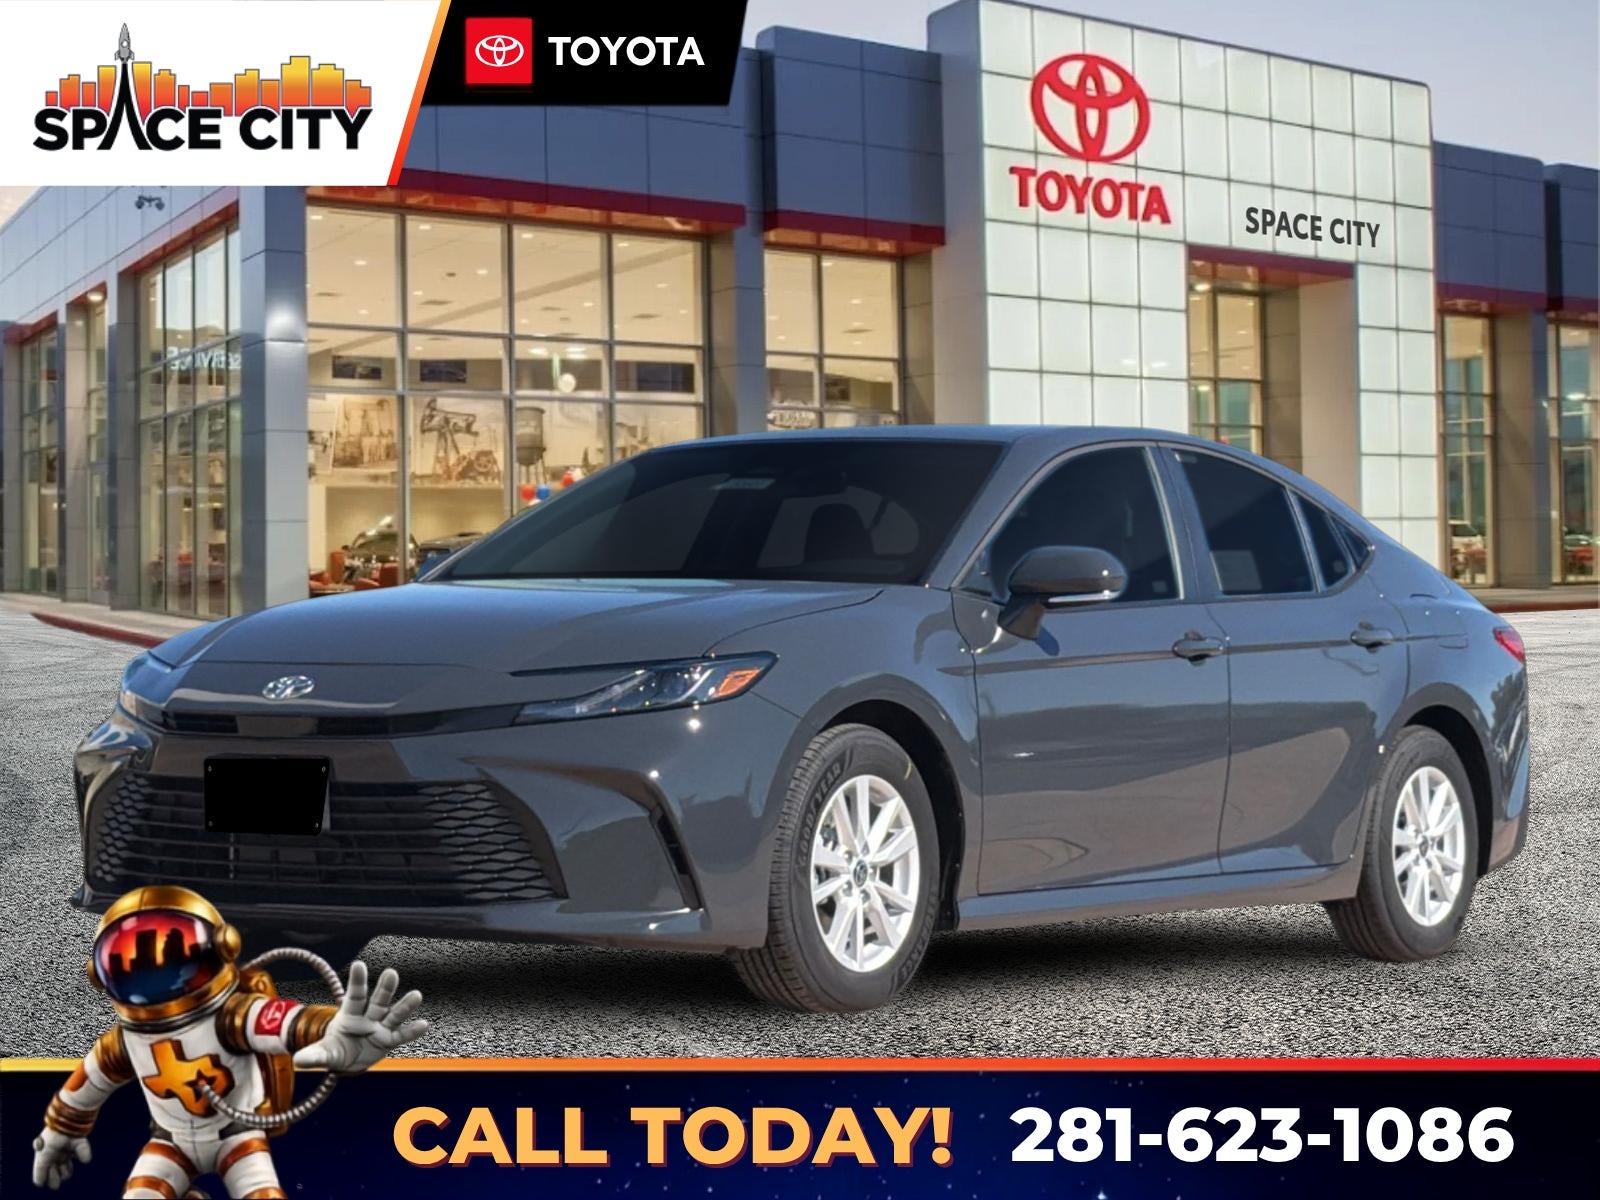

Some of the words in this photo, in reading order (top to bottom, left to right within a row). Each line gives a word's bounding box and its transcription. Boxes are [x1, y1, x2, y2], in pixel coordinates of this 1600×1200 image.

[1009, 166, 1171, 224] TOYOTA
[1245, 206, 1323, 242] SPACE
[1329, 217, 1380, 248] CITY
[797, 761, 842, 867] GOODYEAR
